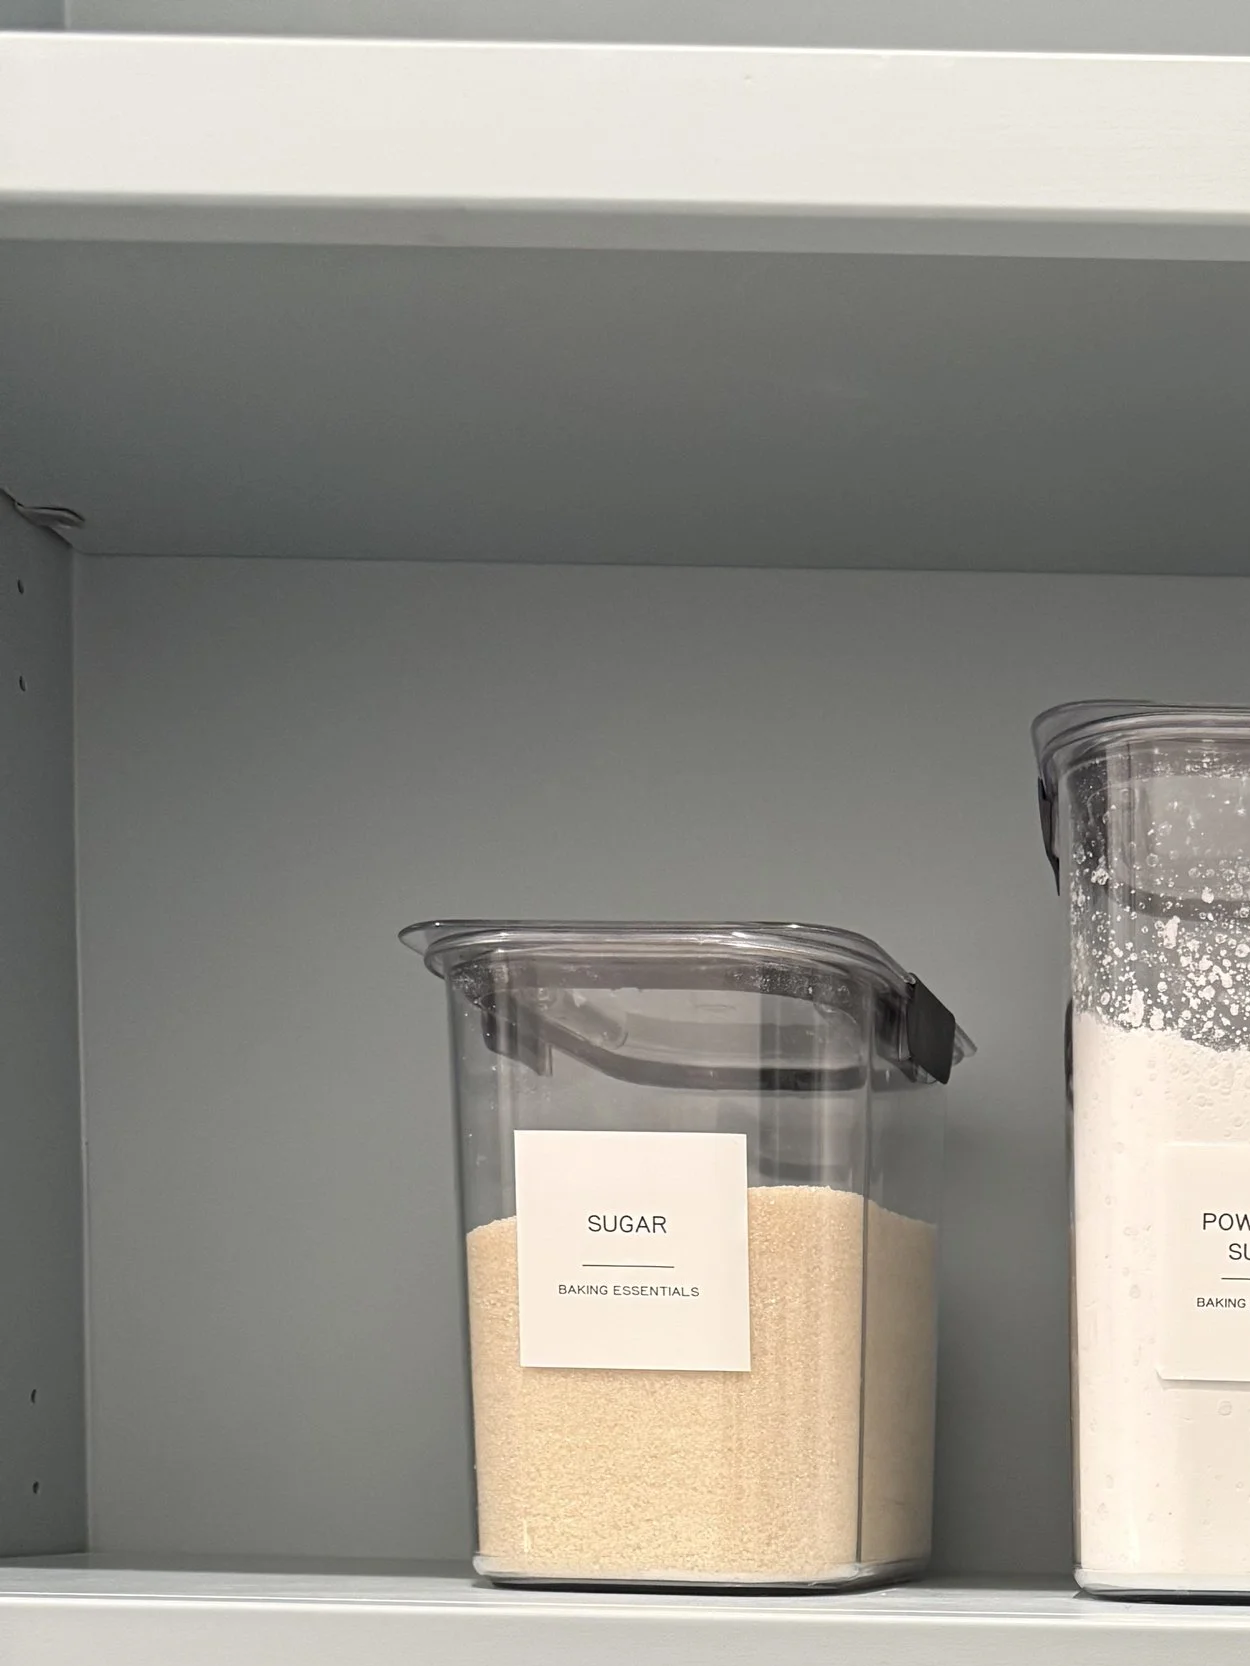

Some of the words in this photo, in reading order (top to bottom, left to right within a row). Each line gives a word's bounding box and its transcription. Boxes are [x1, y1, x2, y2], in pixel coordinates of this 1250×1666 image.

[588, 1214, 667, 1234] SUGAR
[558, 1284, 608, 1295] BAKING
[613, 1285, 700, 1297] ESSENTIALS
[1196, 1297, 1246, 1308] BAKING
